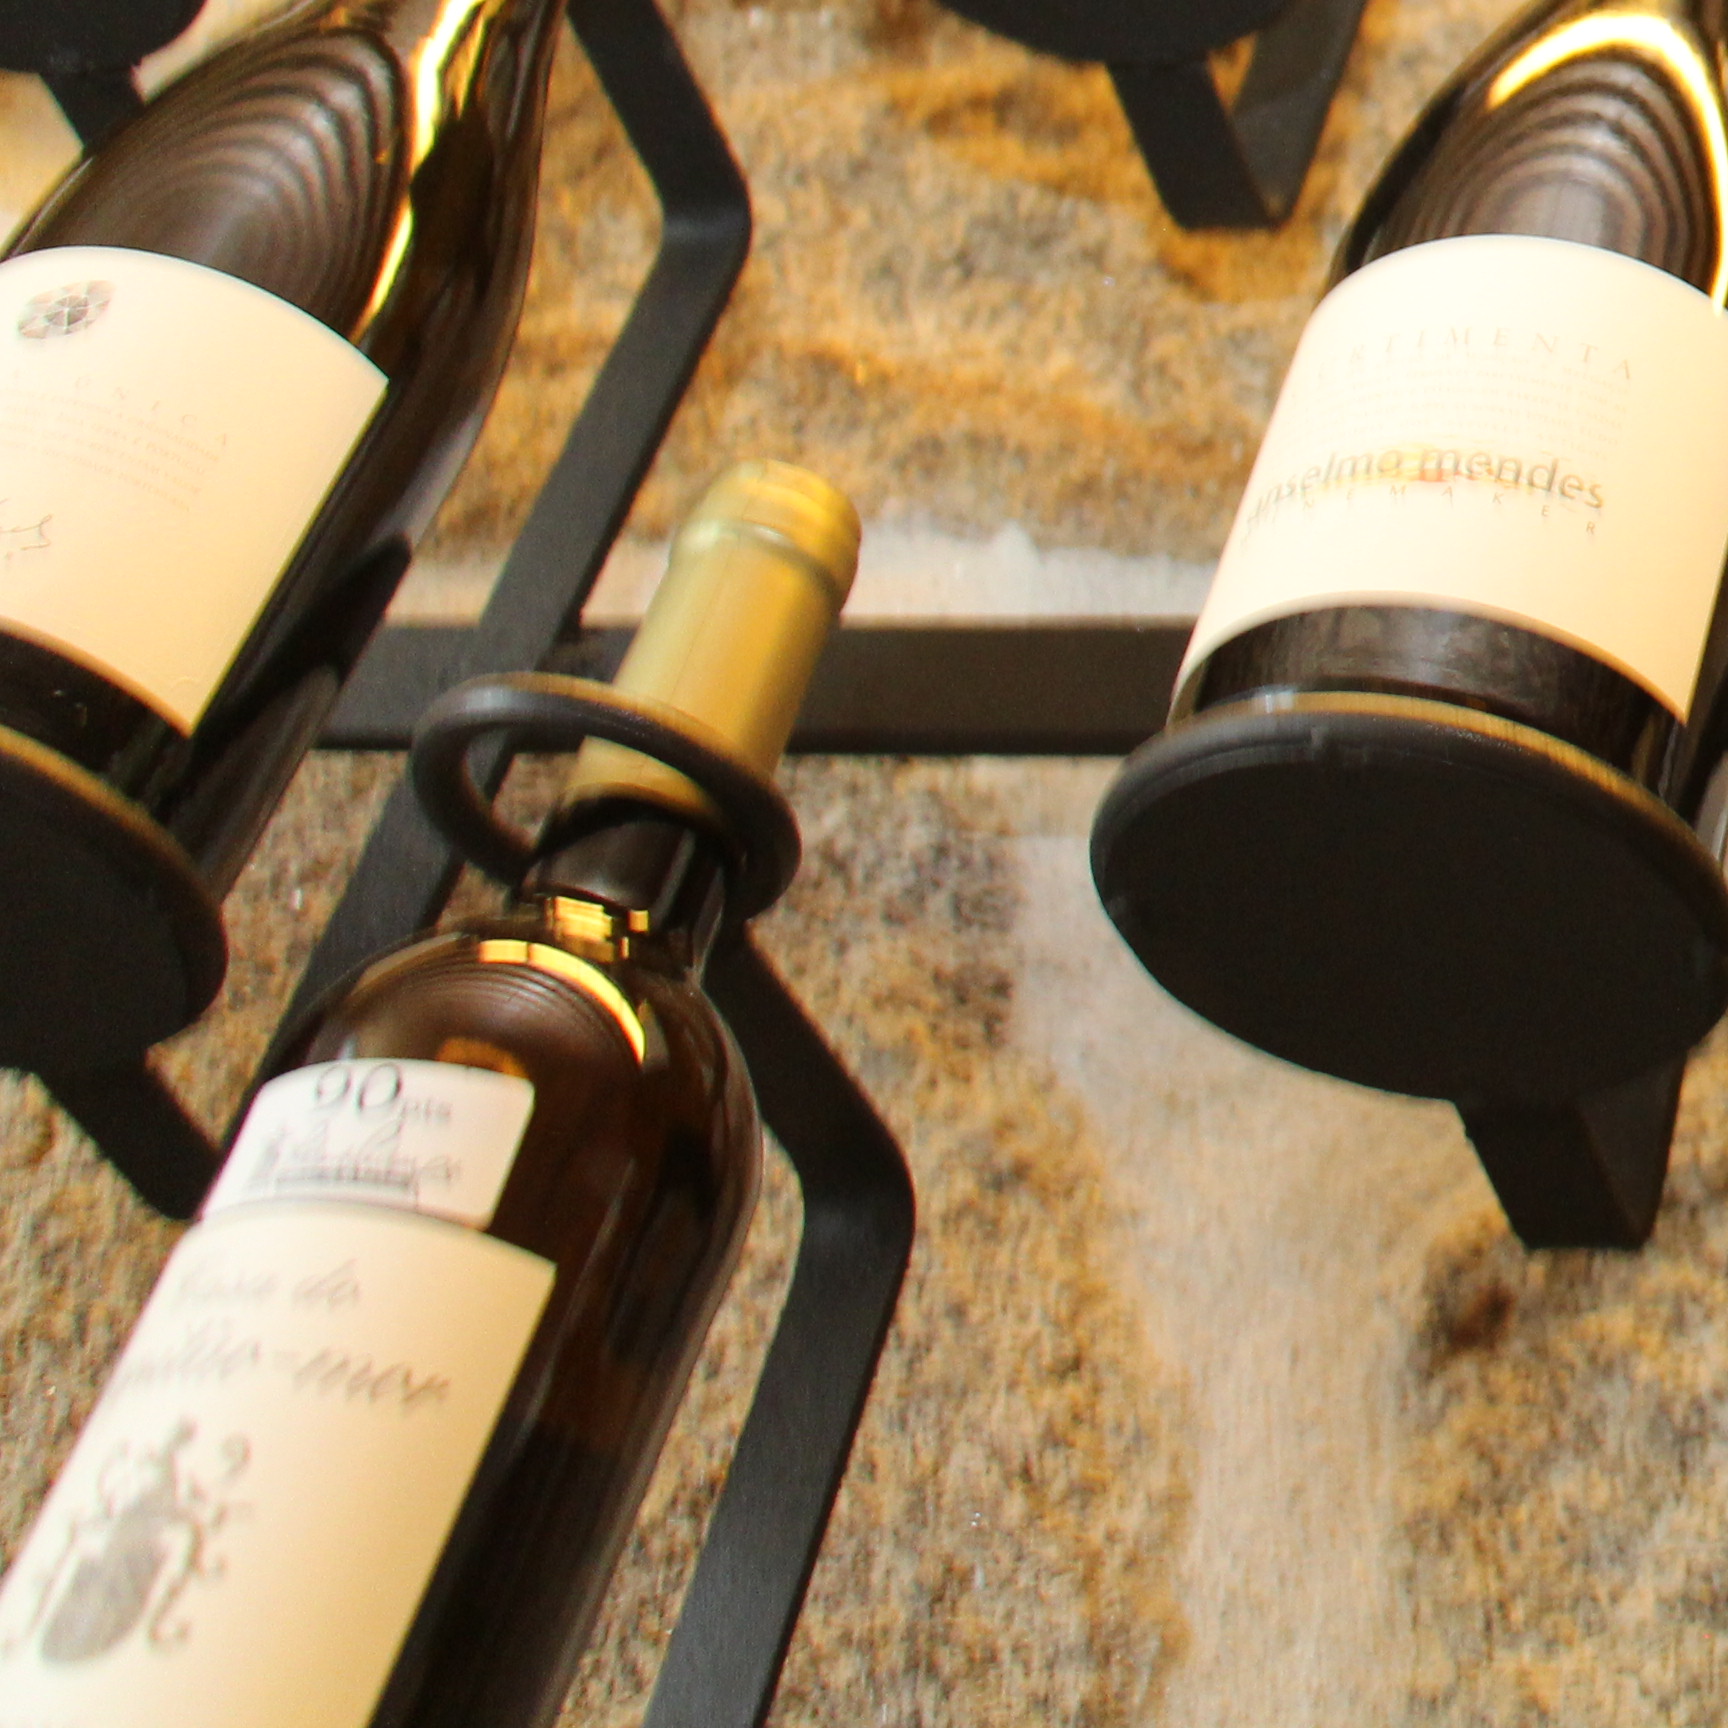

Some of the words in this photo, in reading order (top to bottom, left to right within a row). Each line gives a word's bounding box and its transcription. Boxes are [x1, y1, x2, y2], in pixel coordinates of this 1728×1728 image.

[1240, 448, 1405, 536] anselmo
[1417, 446, 1605, 512] mendes
[313, 1062, 405, 1114] 90
